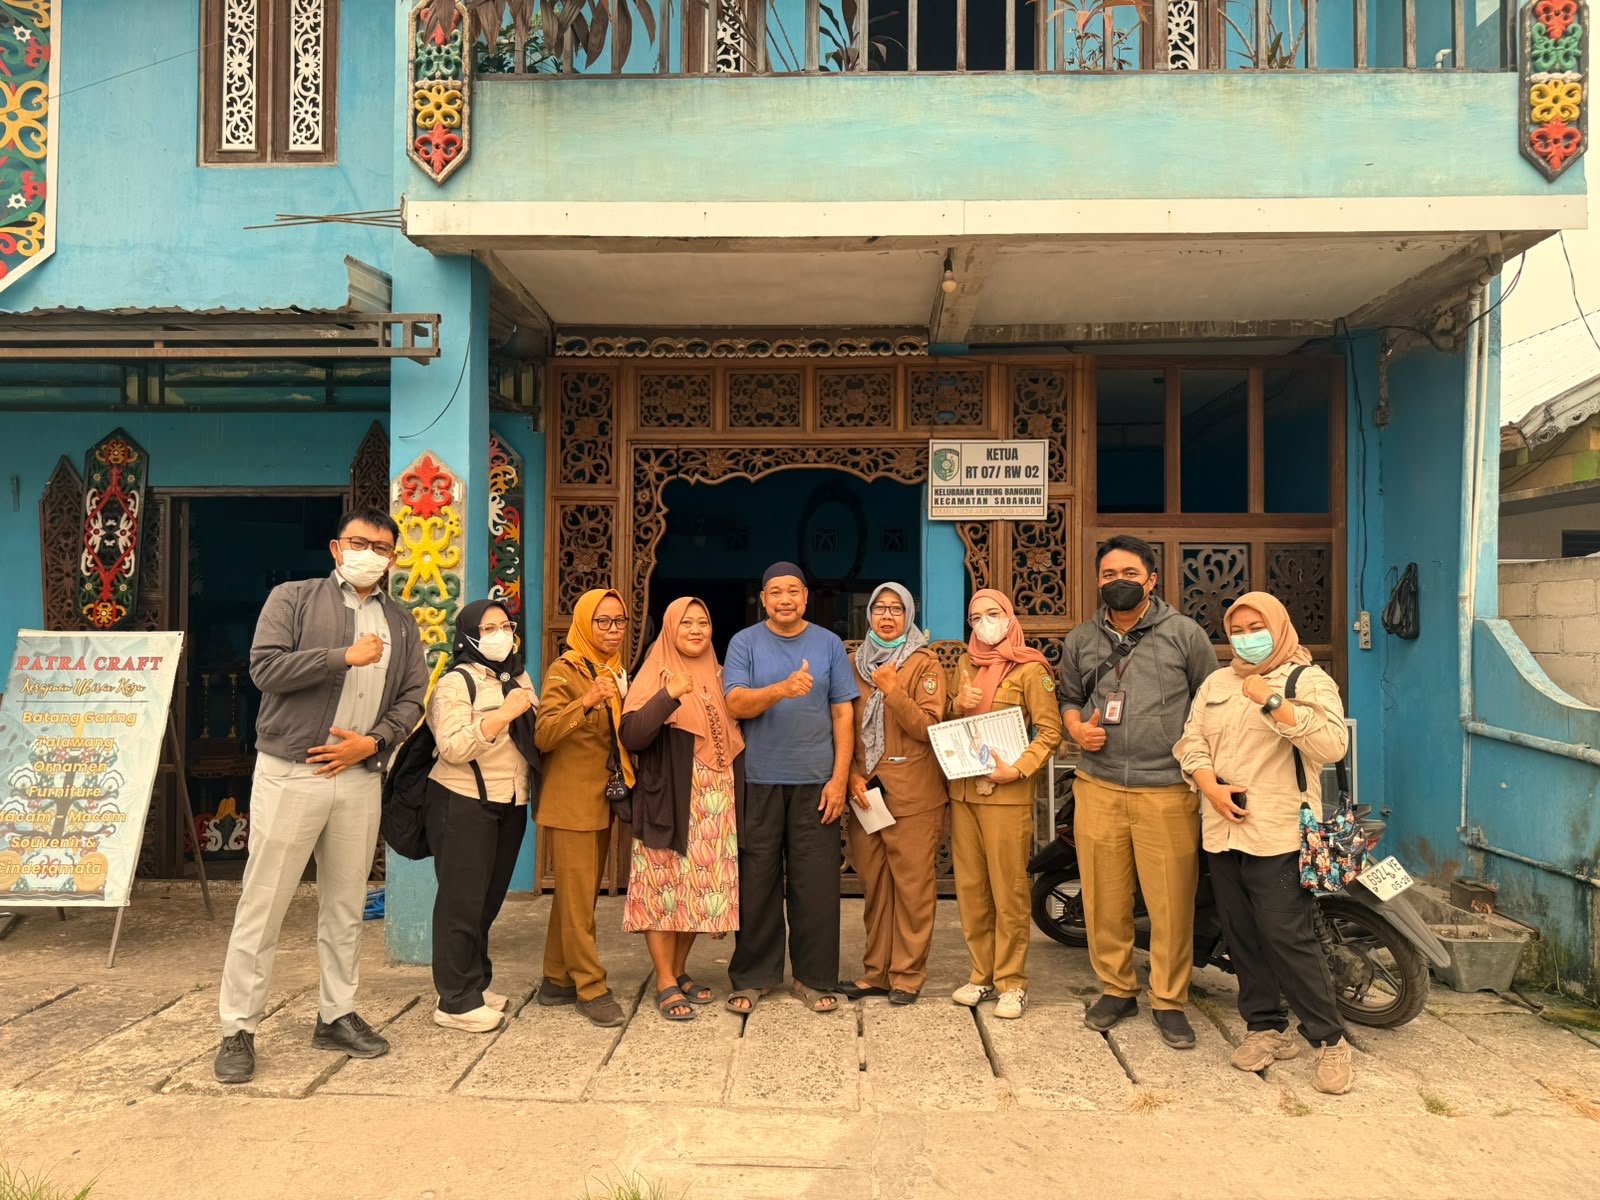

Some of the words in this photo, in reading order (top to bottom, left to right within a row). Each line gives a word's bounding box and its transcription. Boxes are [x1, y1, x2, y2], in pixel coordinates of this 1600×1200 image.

[986, 448, 1018, 461] KETUA
[965, 466, 978, 479] RT
[981, 466, 1001, 479] 07/
[1004, 466, 1021, 479] RW
[1024, 465, 1040, 479] 02
[934, 497, 988, 505] KECAMATAN
[994, 497, 1042, 505] SABANGAU
[15, 656, 87, 671] PATRA
[93, 656, 163, 671] CRAFT
[22, 711, 81, 727] Batang
[83, 710, 137, 727] Garing
[37, 736, 115, 750] Talawang
[33, 761, 108, 774] Ornamen
[28, 785, 102, 797] Furniture
[68, 811, 128, 823] Macam
[11, 836, 81, 848] Souvenir
[85, 837, 98, 849] &
